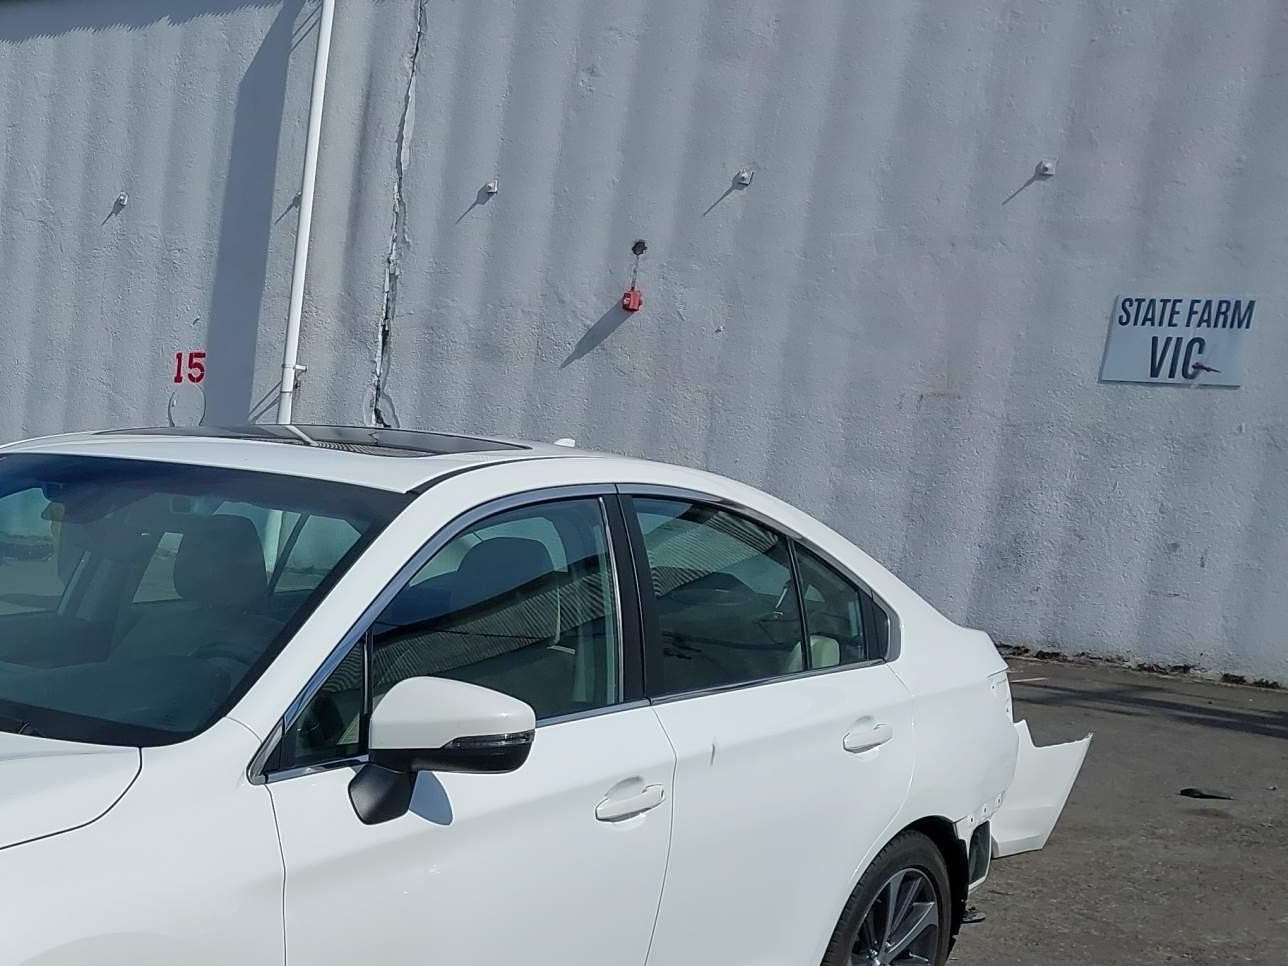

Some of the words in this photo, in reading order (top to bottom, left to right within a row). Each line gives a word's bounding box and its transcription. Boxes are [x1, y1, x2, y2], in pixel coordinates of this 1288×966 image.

[1118, 298, 1182, 327] STATE
[1185, 299, 1256, 329] FARM
[174, 352, 206, 383] 15
[1149, 336, 1206, 380] VIC
